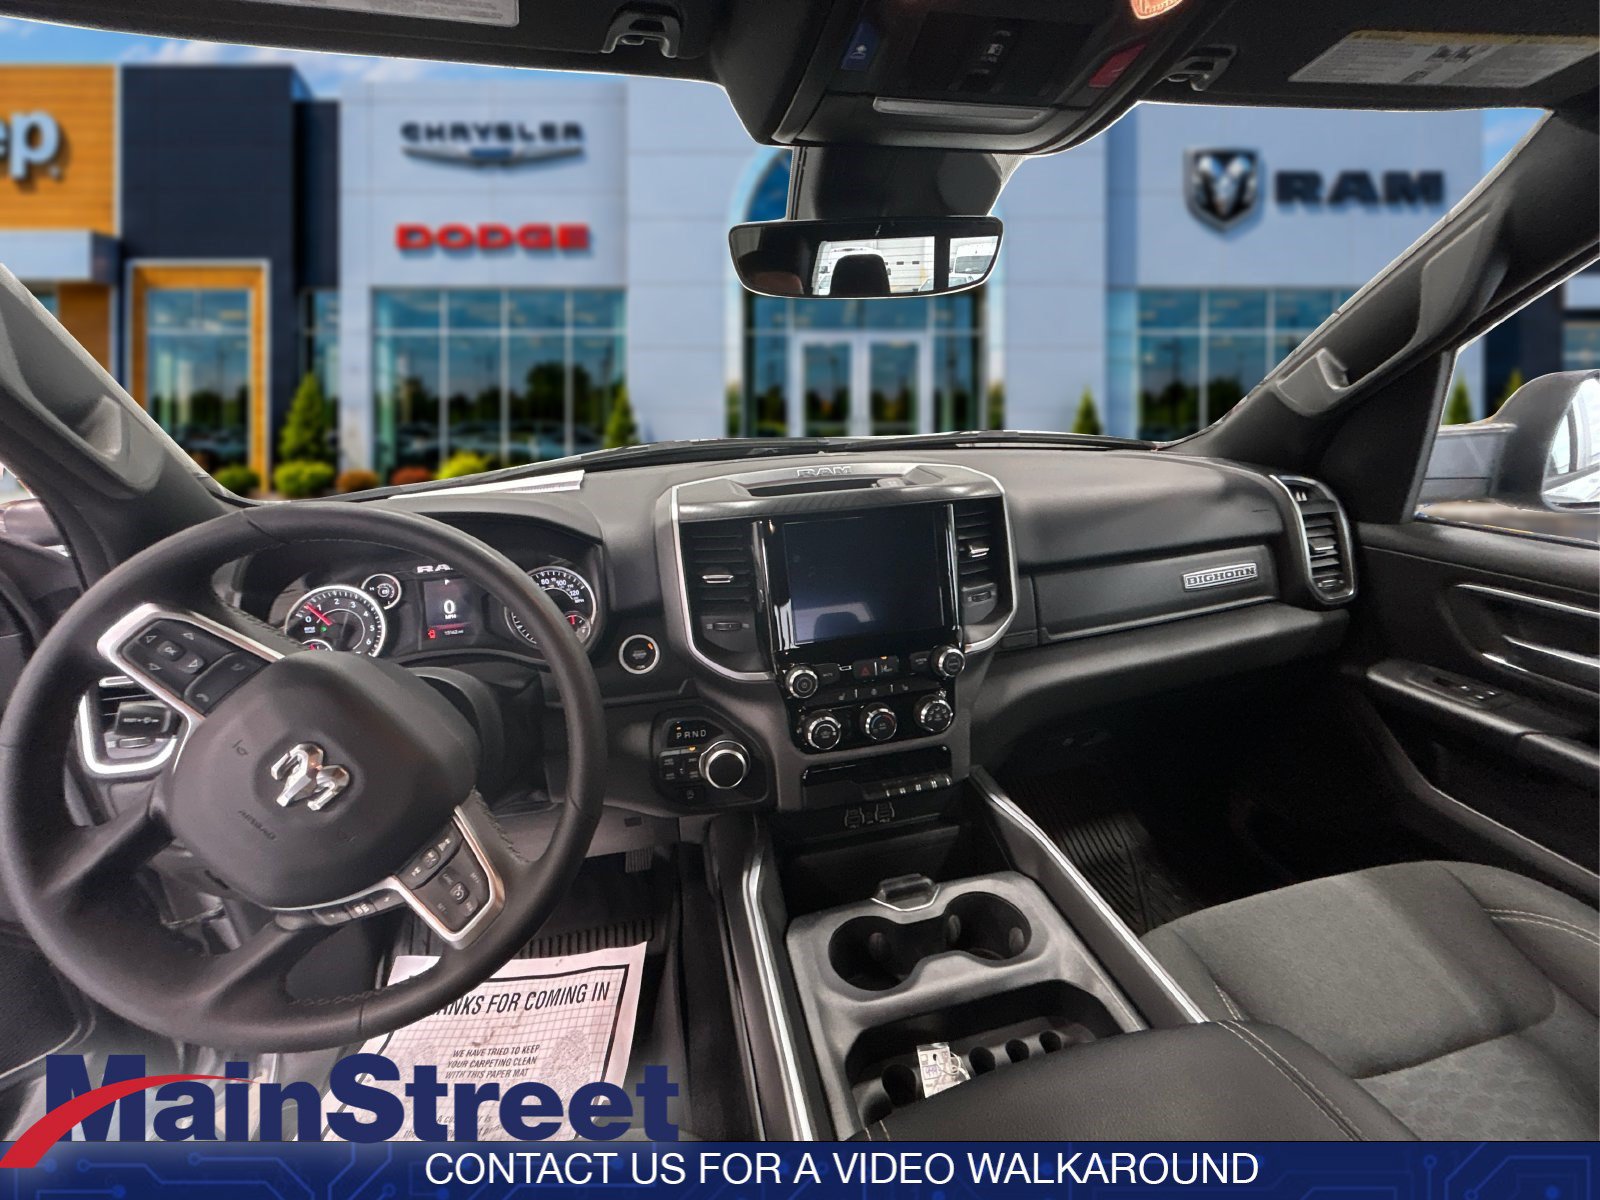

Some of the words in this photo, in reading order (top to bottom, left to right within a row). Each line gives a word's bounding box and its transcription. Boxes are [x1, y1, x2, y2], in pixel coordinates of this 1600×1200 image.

[400, 122, 583, 143] CHRYSLER
[1275, 170, 1444, 205] RAM
[396, 222, 590, 250] DODGE
[796, 466, 851, 477] RAM
[416, 563, 453, 574] RA
[1186, 567, 1255, 585] BIGHORN
[443, 599, 455, 614] 0
[304, 615, 312, 623] 0
[486, 991, 521, 1014] FOR
[524, 983, 588, 1011] COMING
[592, 981, 610, 1001] IN
[453, 1049, 466, 1058] WE
[466, 1048, 487, 1057] HAVE
[488, 1047, 510, 1056] TRIED
[511, 1046, 521, 1055] TO
[522, 1044, 540, 1054] KEEP
[447, 1060, 469, 1069] YOUR
[469, 1058, 512, 1068] CARPETING
[512, 1056, 538, 1067] CLEAN
[445, 1070, 467, 1079] WITH
[466, 1070, 486, 1079] THIS
[486, 1068, 512, 1078] PAPER
[513, 1068, 529, 1077] MAT
